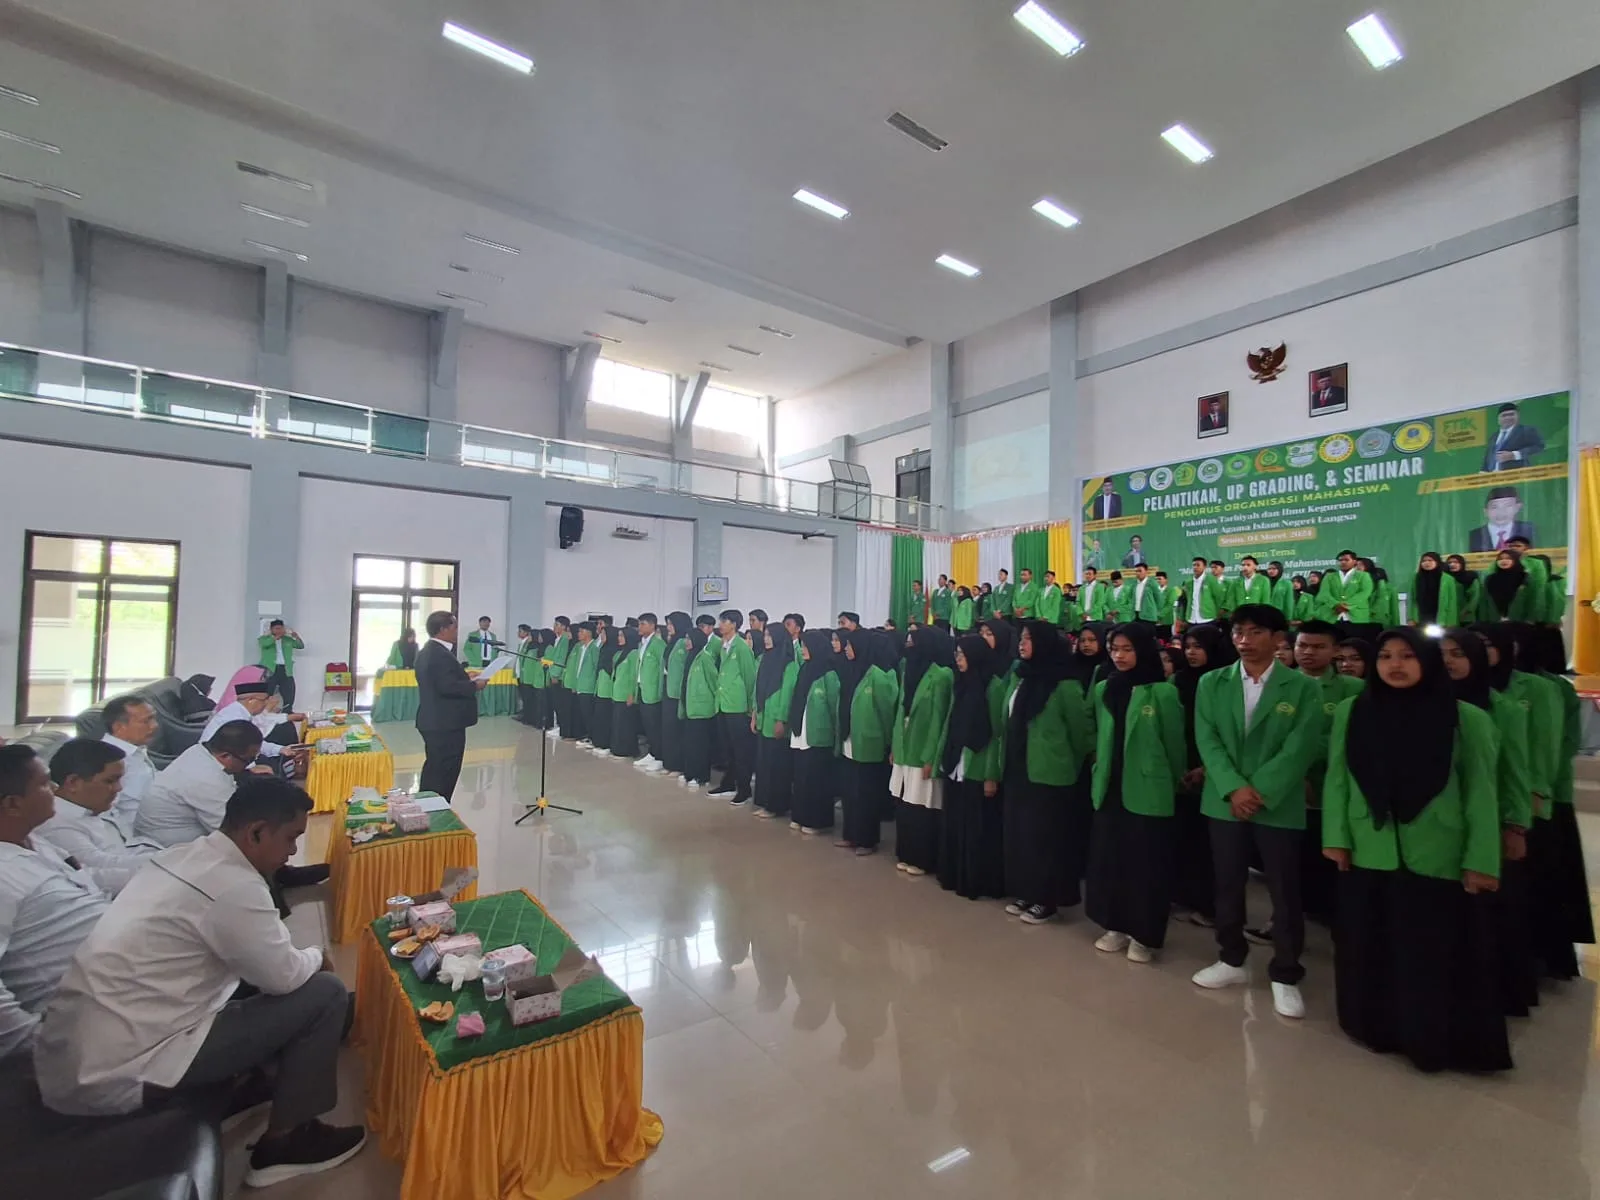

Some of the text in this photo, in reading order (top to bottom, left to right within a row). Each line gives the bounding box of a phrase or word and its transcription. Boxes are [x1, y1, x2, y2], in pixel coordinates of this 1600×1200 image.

[1143, 457, 1424, 512] PELANTIKAN, UP GRADING, & SEMINAR
[1164, 483, 1391, 519] PENGURUS ORGANISASI MAHASISWA
[1186, 526, 1219, 537] Institut
[1252, 519, 1280, 531] Islam
[1282, 515, 1316, 529] Negeri
[1317, 512, 1358, 525] Langsa
[1261, 510, 1280, 519] dan
[1270, 547, 1297, 557] Tema
